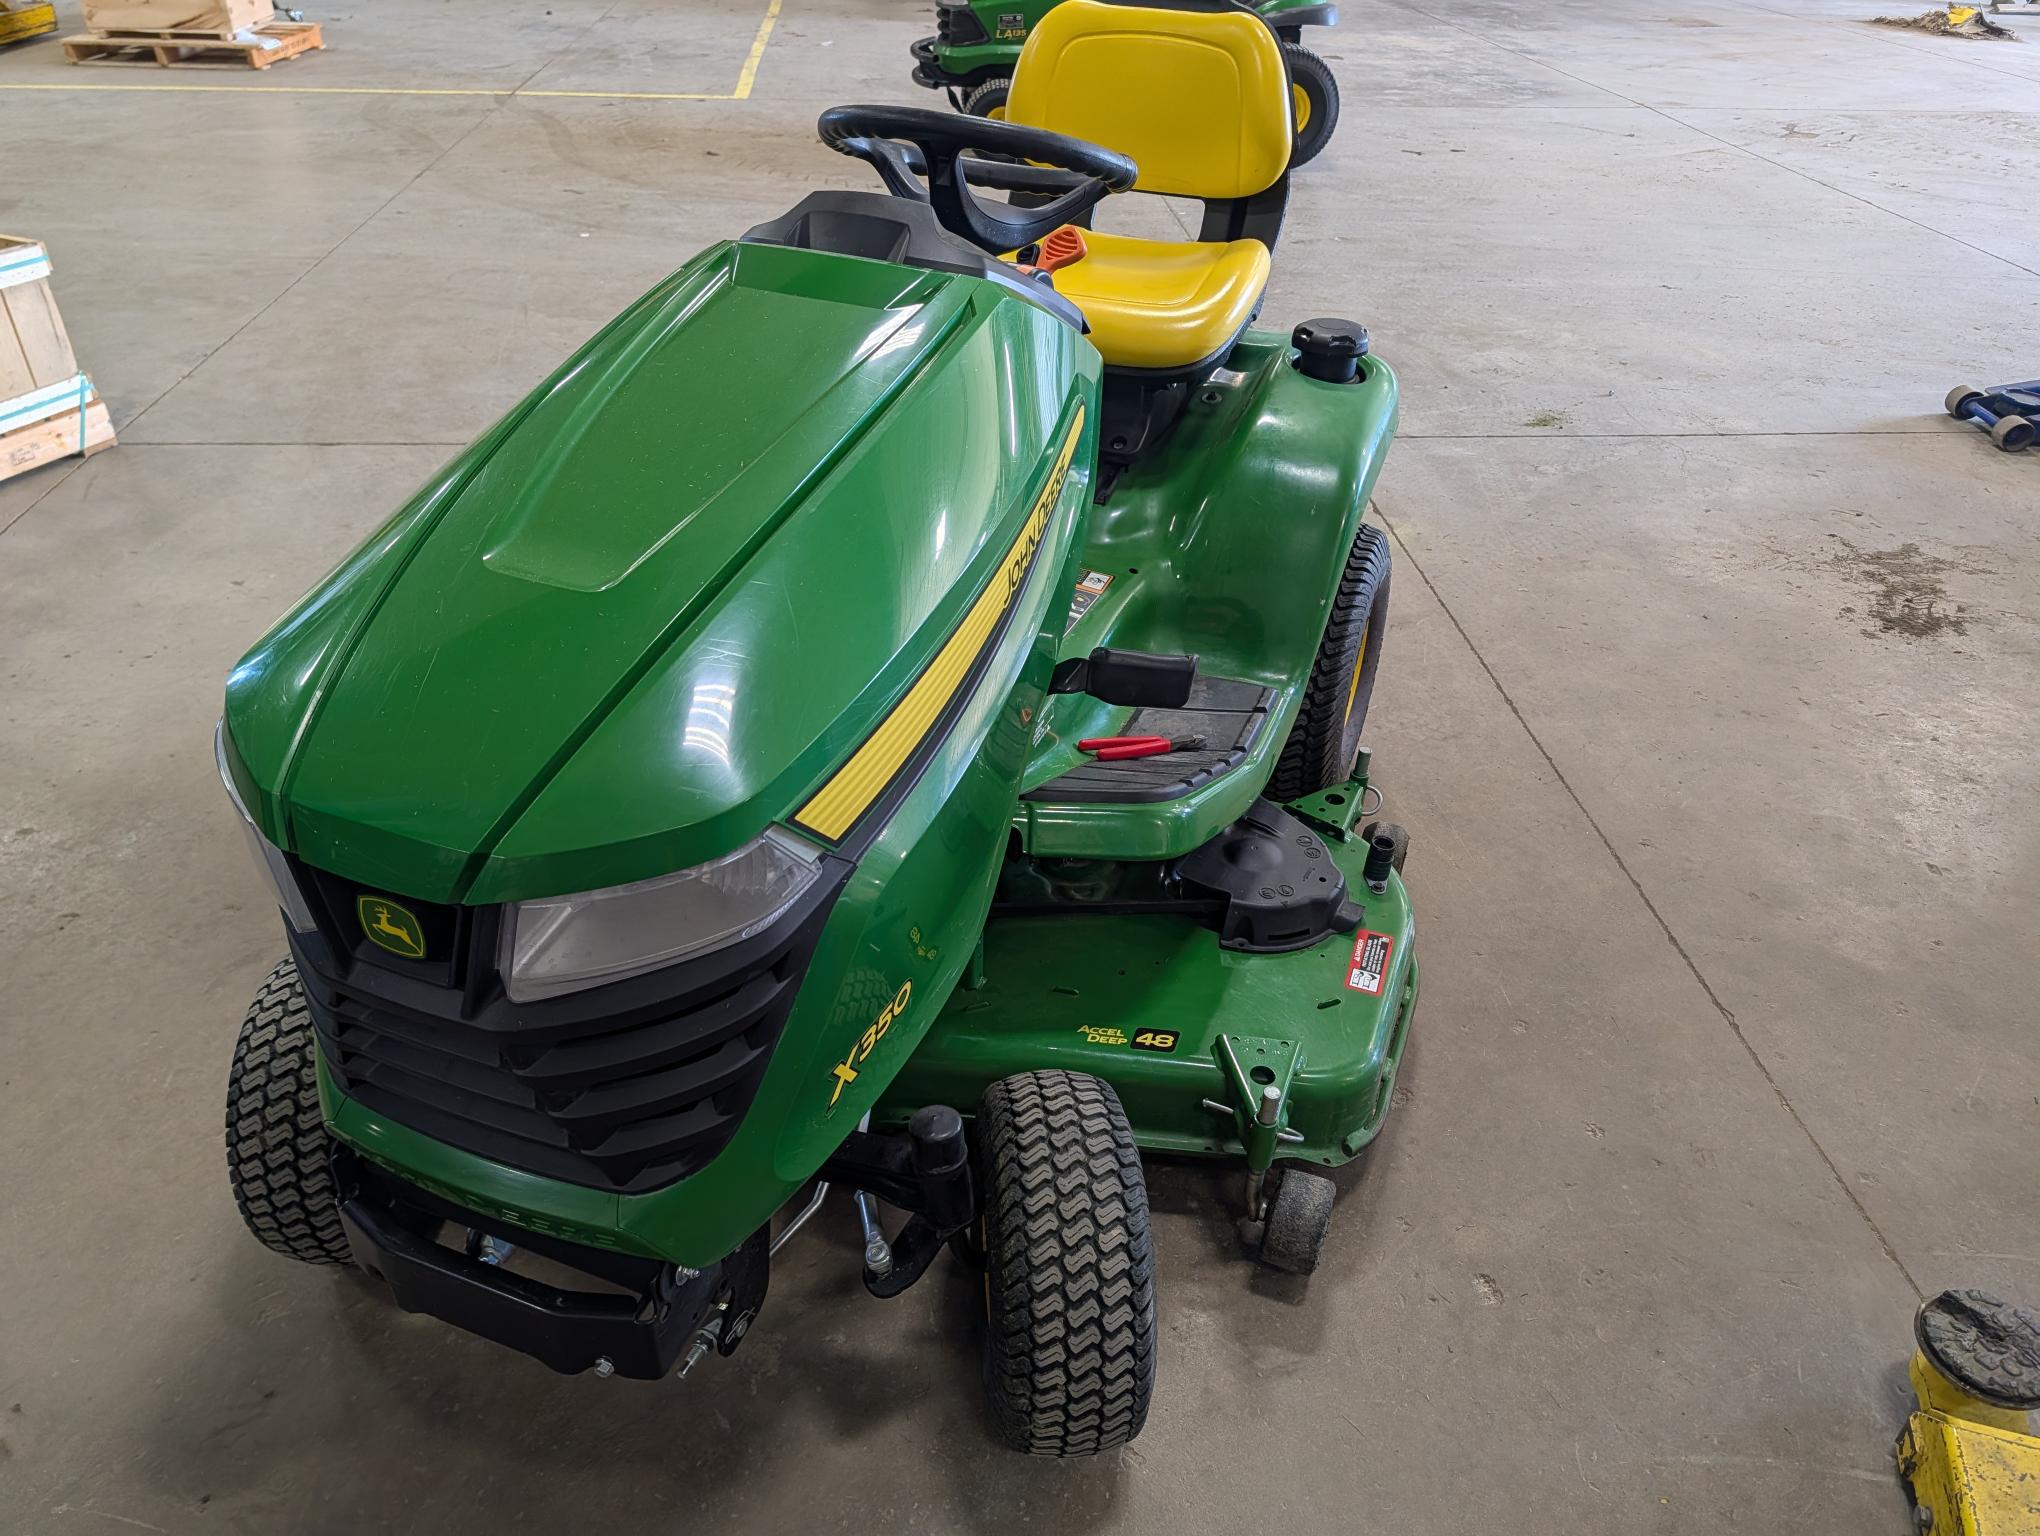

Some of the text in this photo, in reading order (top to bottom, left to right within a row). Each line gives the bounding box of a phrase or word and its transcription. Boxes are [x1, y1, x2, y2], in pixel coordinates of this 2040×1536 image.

[1004, 453, 1067, 605] JOHN DEERE
[828, 978, 912, 1110] X350
[1135, 1032, 1175, 1048] 48
